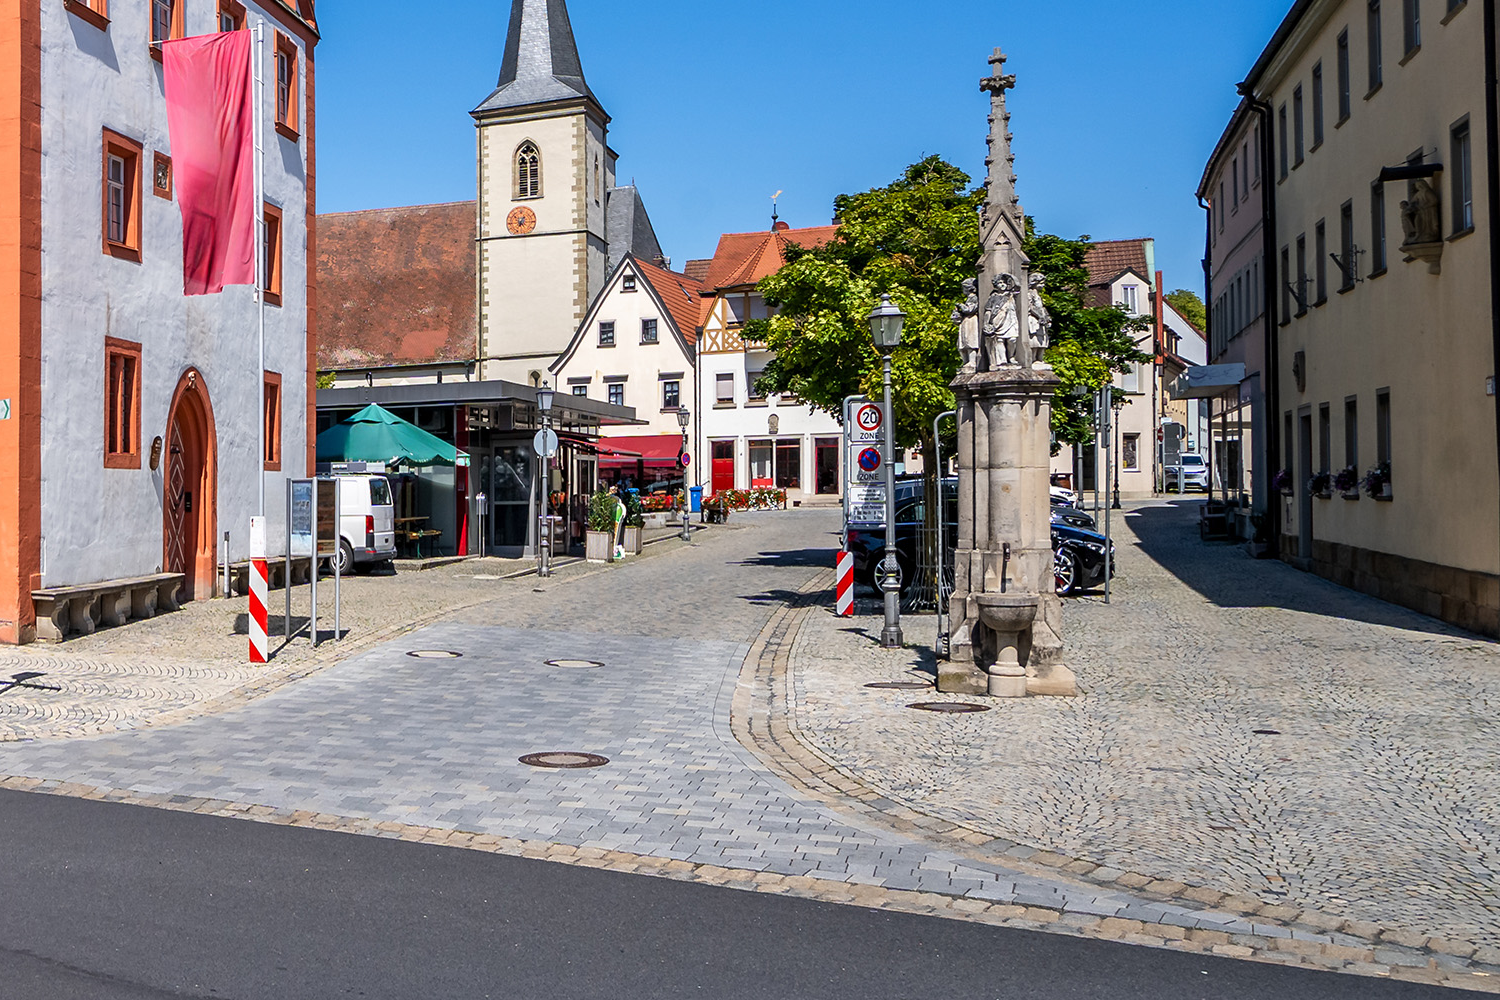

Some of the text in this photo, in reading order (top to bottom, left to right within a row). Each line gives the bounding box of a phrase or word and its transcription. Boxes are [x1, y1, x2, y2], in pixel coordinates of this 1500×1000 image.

[862, 411, 878, 424] 20
[859, 432, 879, 440] ZONE
[859, 473, 879, 481] ZONE
